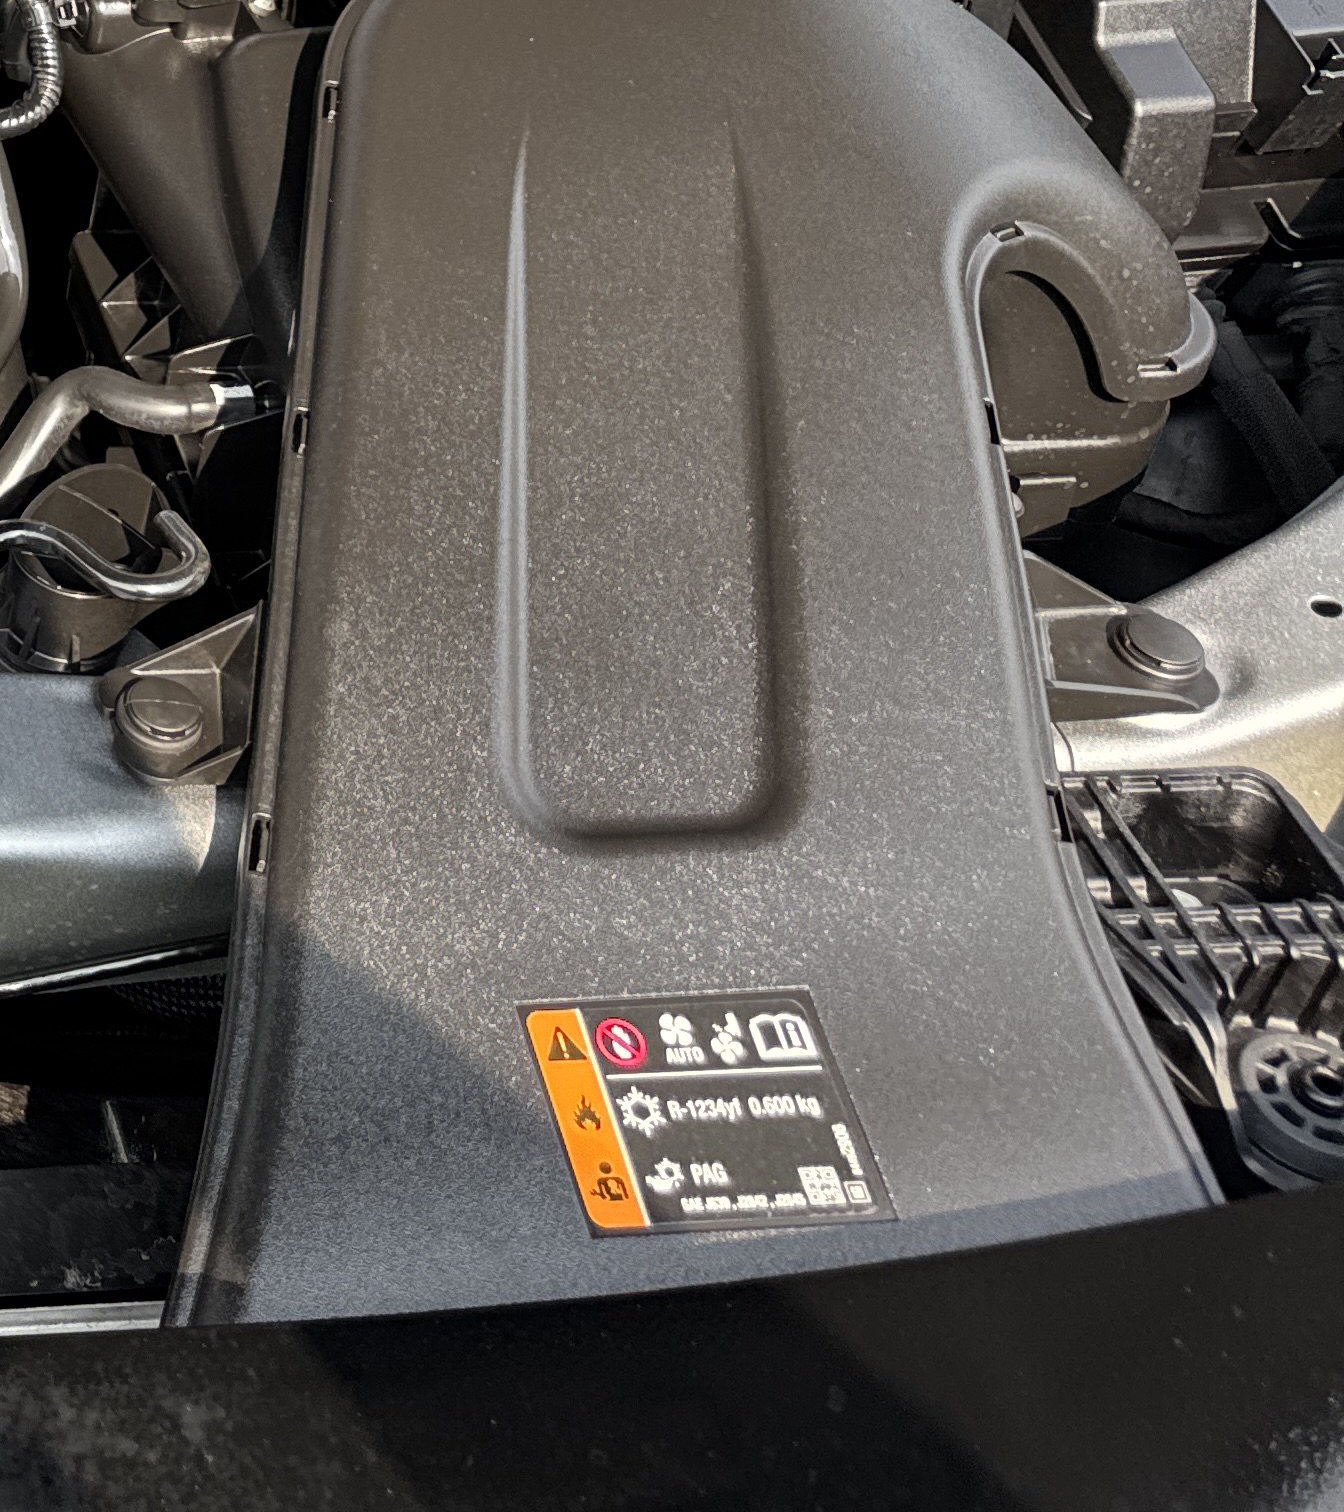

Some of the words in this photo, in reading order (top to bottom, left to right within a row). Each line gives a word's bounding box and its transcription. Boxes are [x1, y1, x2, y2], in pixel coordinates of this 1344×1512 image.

[665, 1046, 705, 1065] AUTO
[666, 1096, 741, 1120] R-1234yf
[749, 1095, 795, 1117] 0.600
[797, 1094, 823, 1119] kg
[689, 1163, 730, 1186] PAG
